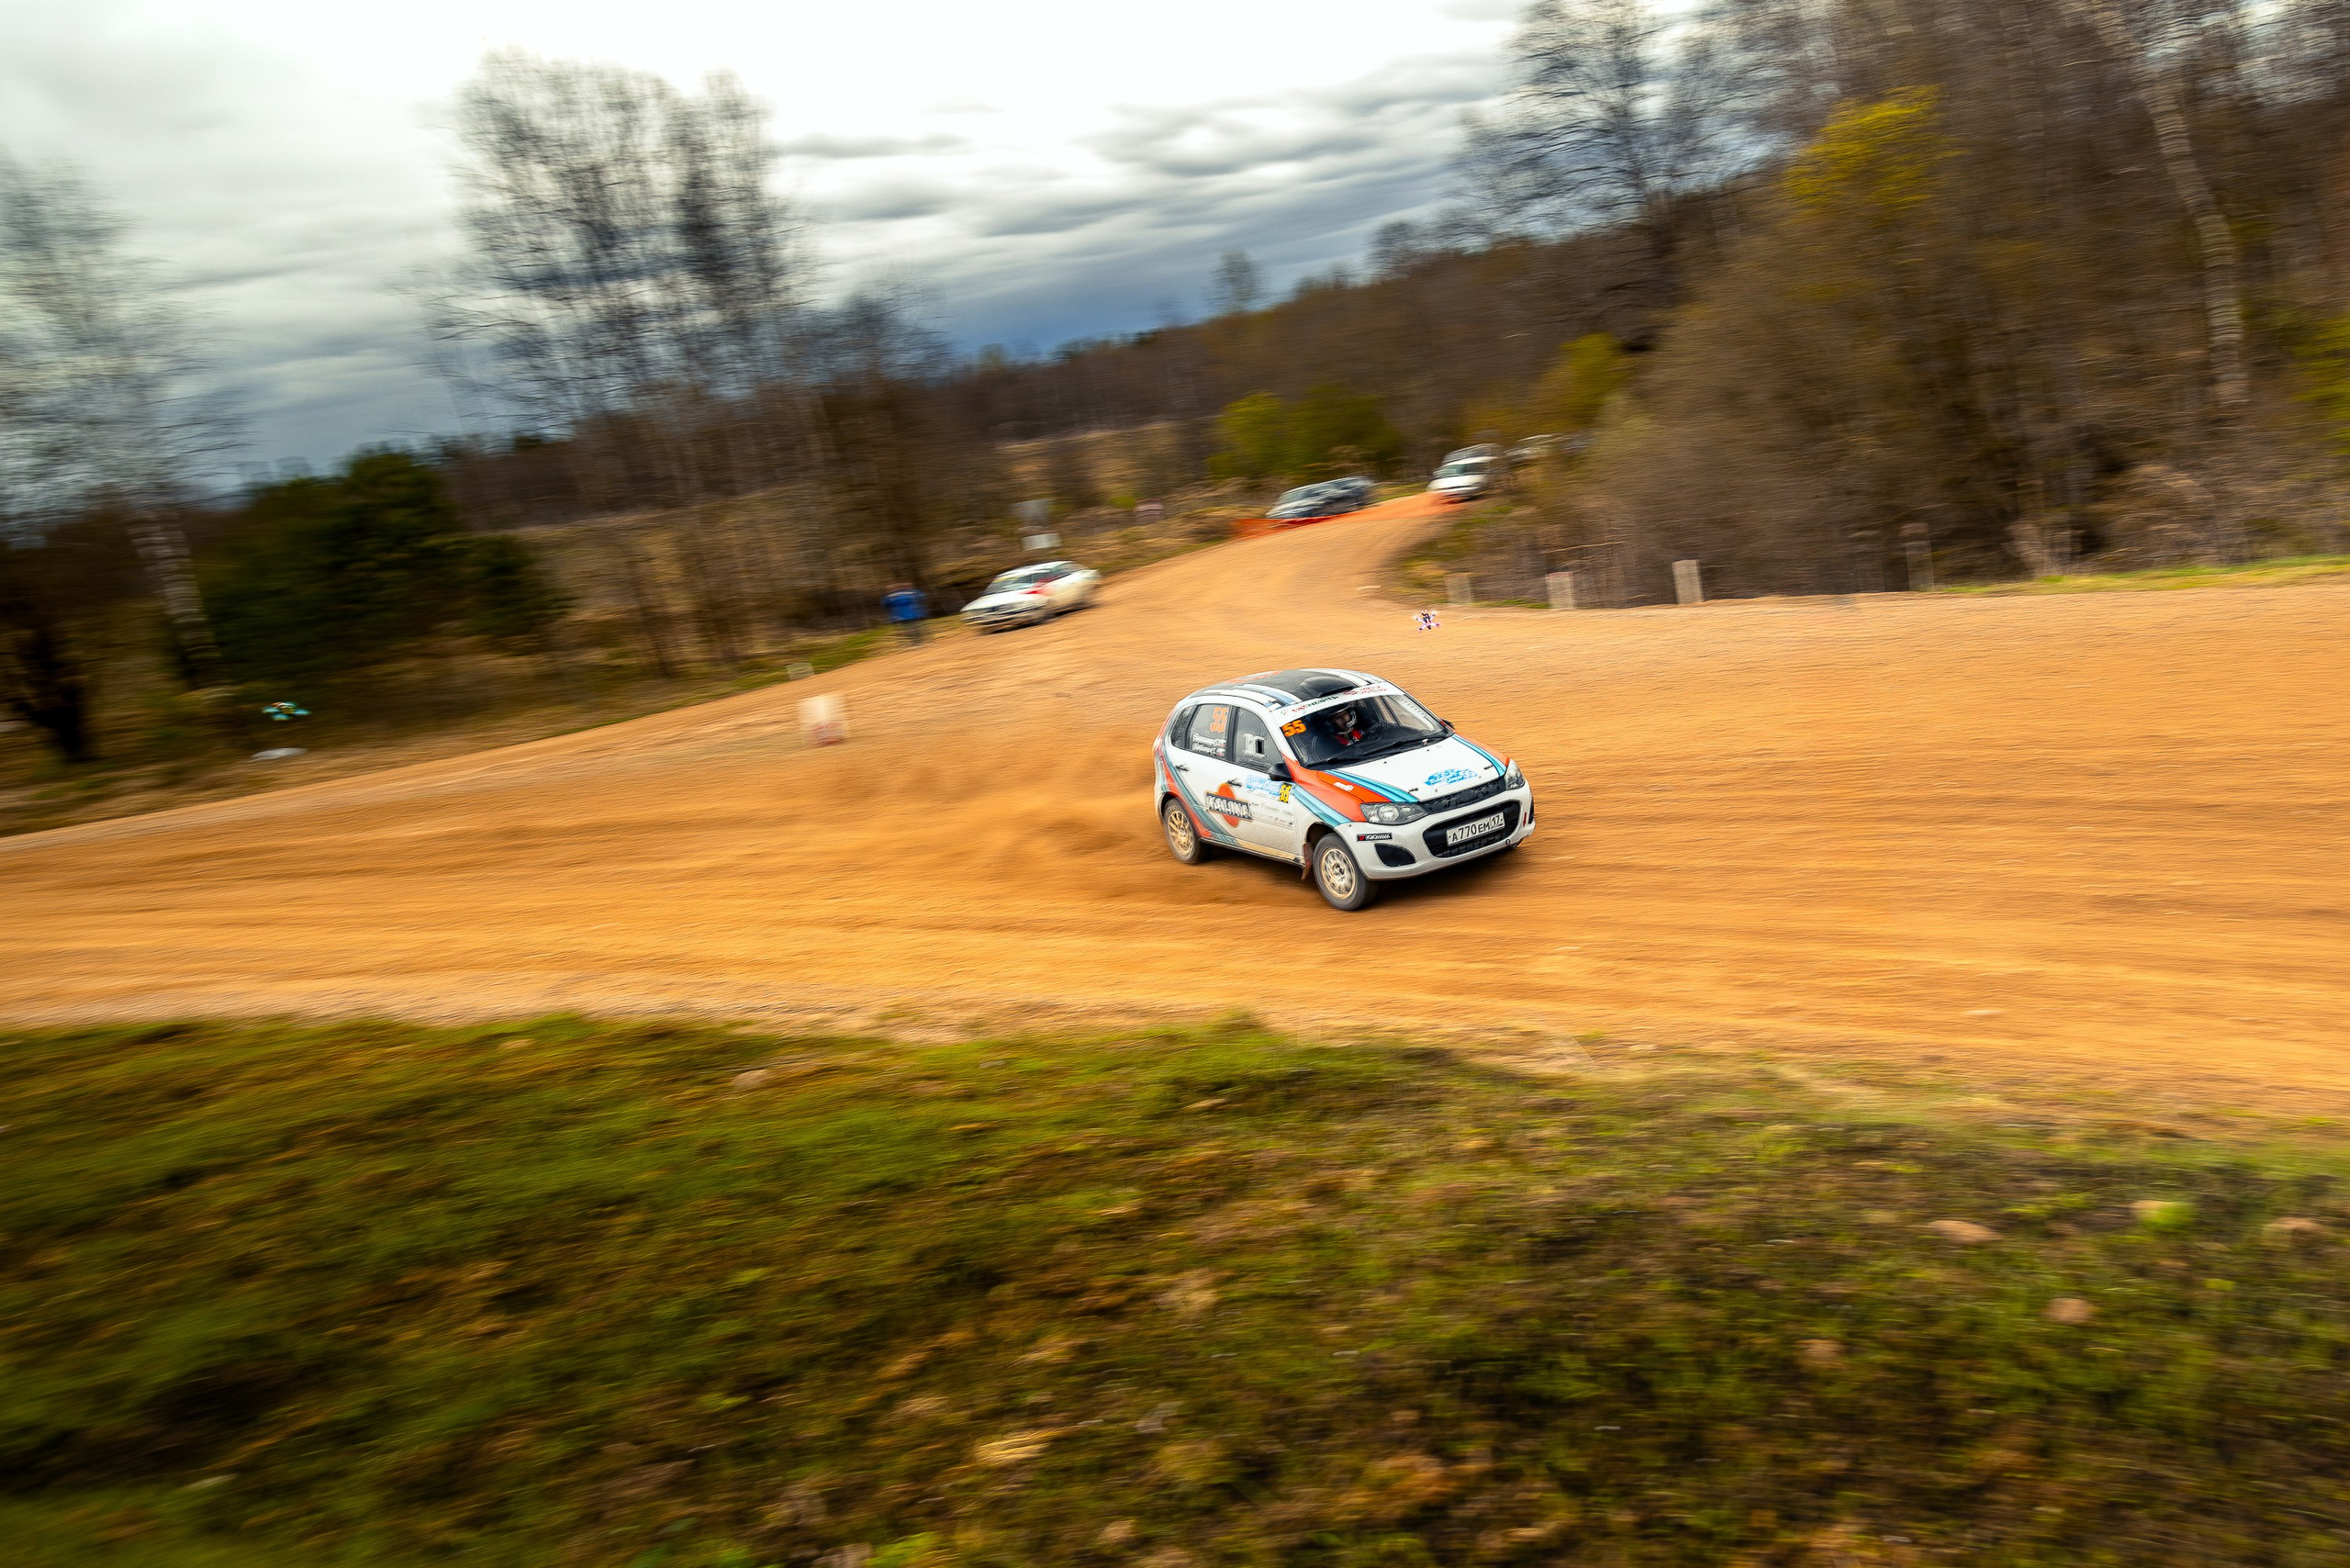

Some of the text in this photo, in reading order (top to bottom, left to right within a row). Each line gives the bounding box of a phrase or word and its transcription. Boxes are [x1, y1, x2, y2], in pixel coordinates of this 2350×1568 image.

[1209, 706, 1228, 733] 55
[1281, 720, 1307, 737] 55
[1279, 784, 1292, 803] 55
[1206, 795, 1251, 818] KALINA
